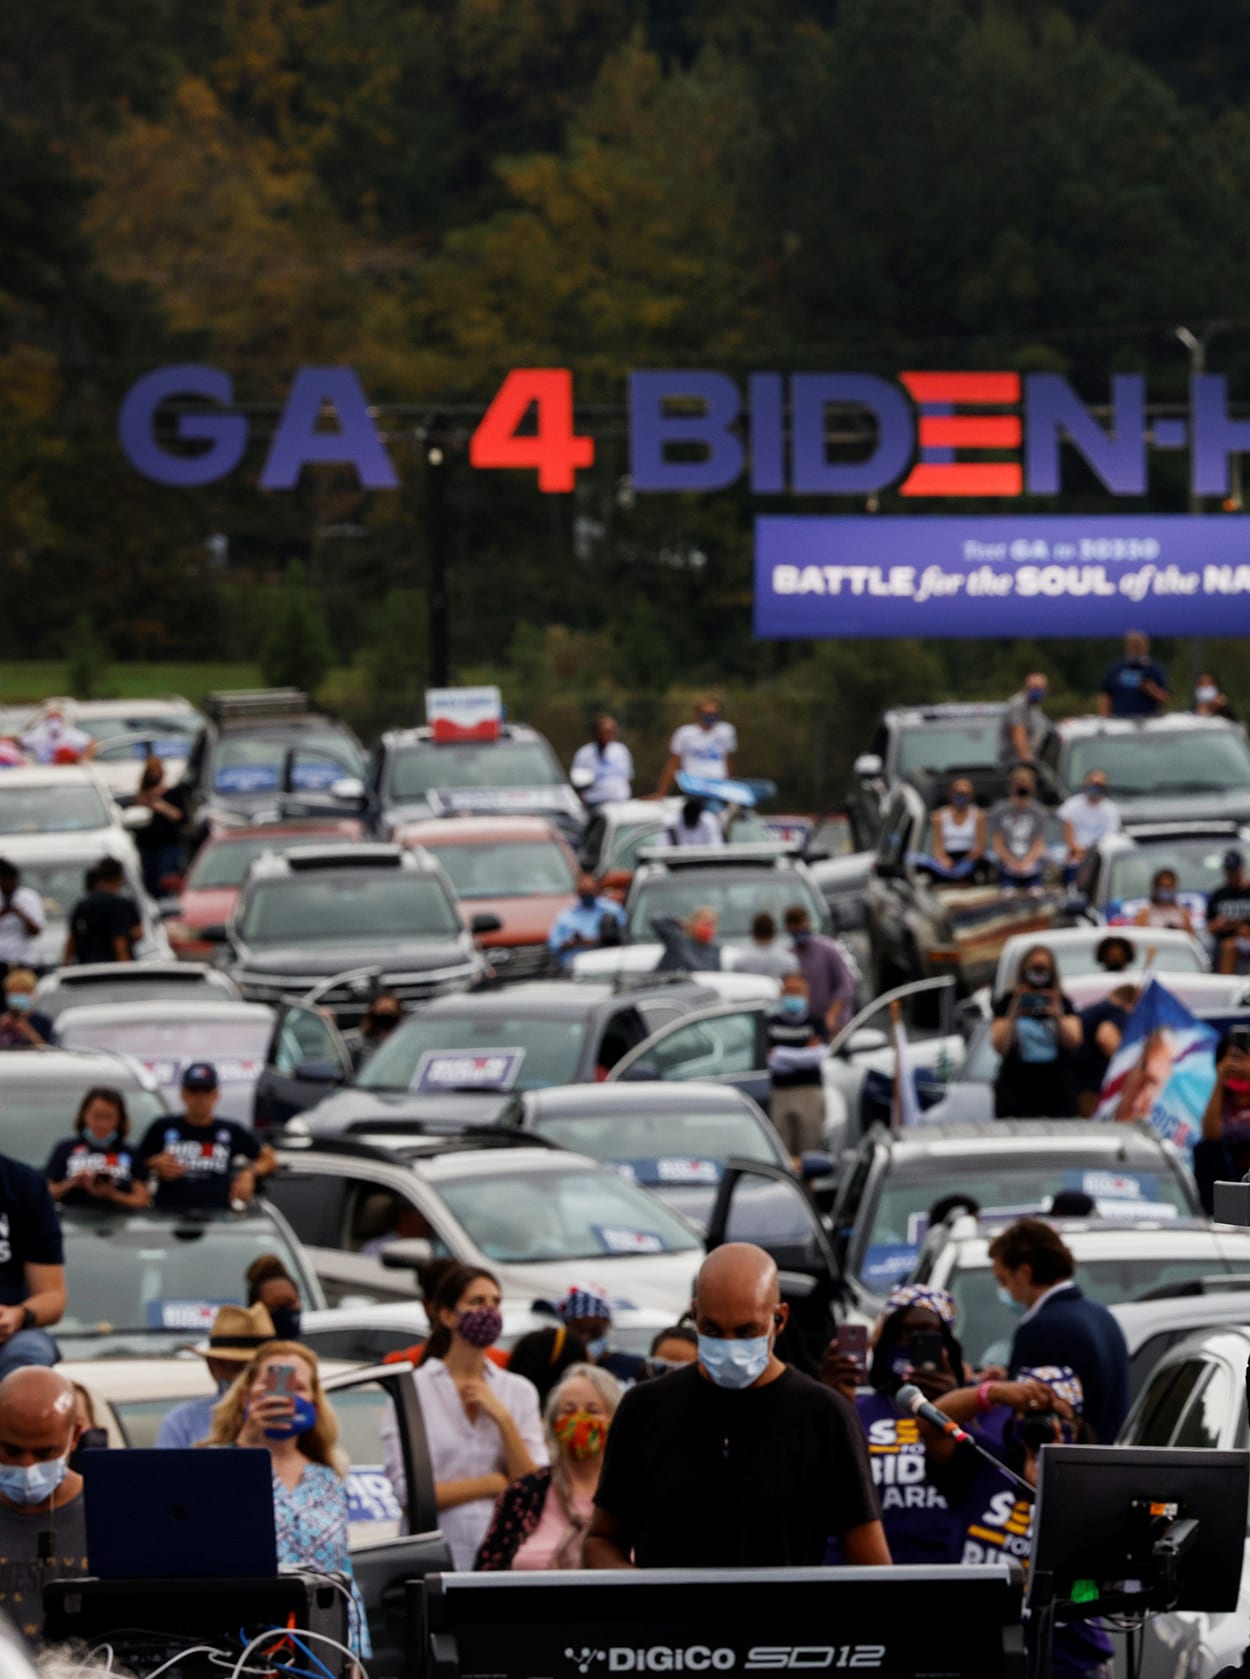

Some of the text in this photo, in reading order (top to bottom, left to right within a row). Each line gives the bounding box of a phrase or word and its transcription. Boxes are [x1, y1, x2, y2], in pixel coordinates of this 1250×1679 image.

[119, 363, 399, 491] GA
[469, 368, 595, 493] 4
[1010, 538, 1050, 562] GA
[772, 565, 916, 596] BATTLE
[917, 565, 965, 601] for
[966, 565, 1013, 596] the
[1014, 565, 1117, 597] SOUL
[1118, 564, 1157, 602] of
[1153, 565, 1199, 596] the
[869, 1419, 920, 1445] SE
[901, 1443, 926, 1455] FO
[870, 1455, 926, 1486] BID
[609, 1645, 886, 1671] DiGiCo SD12
